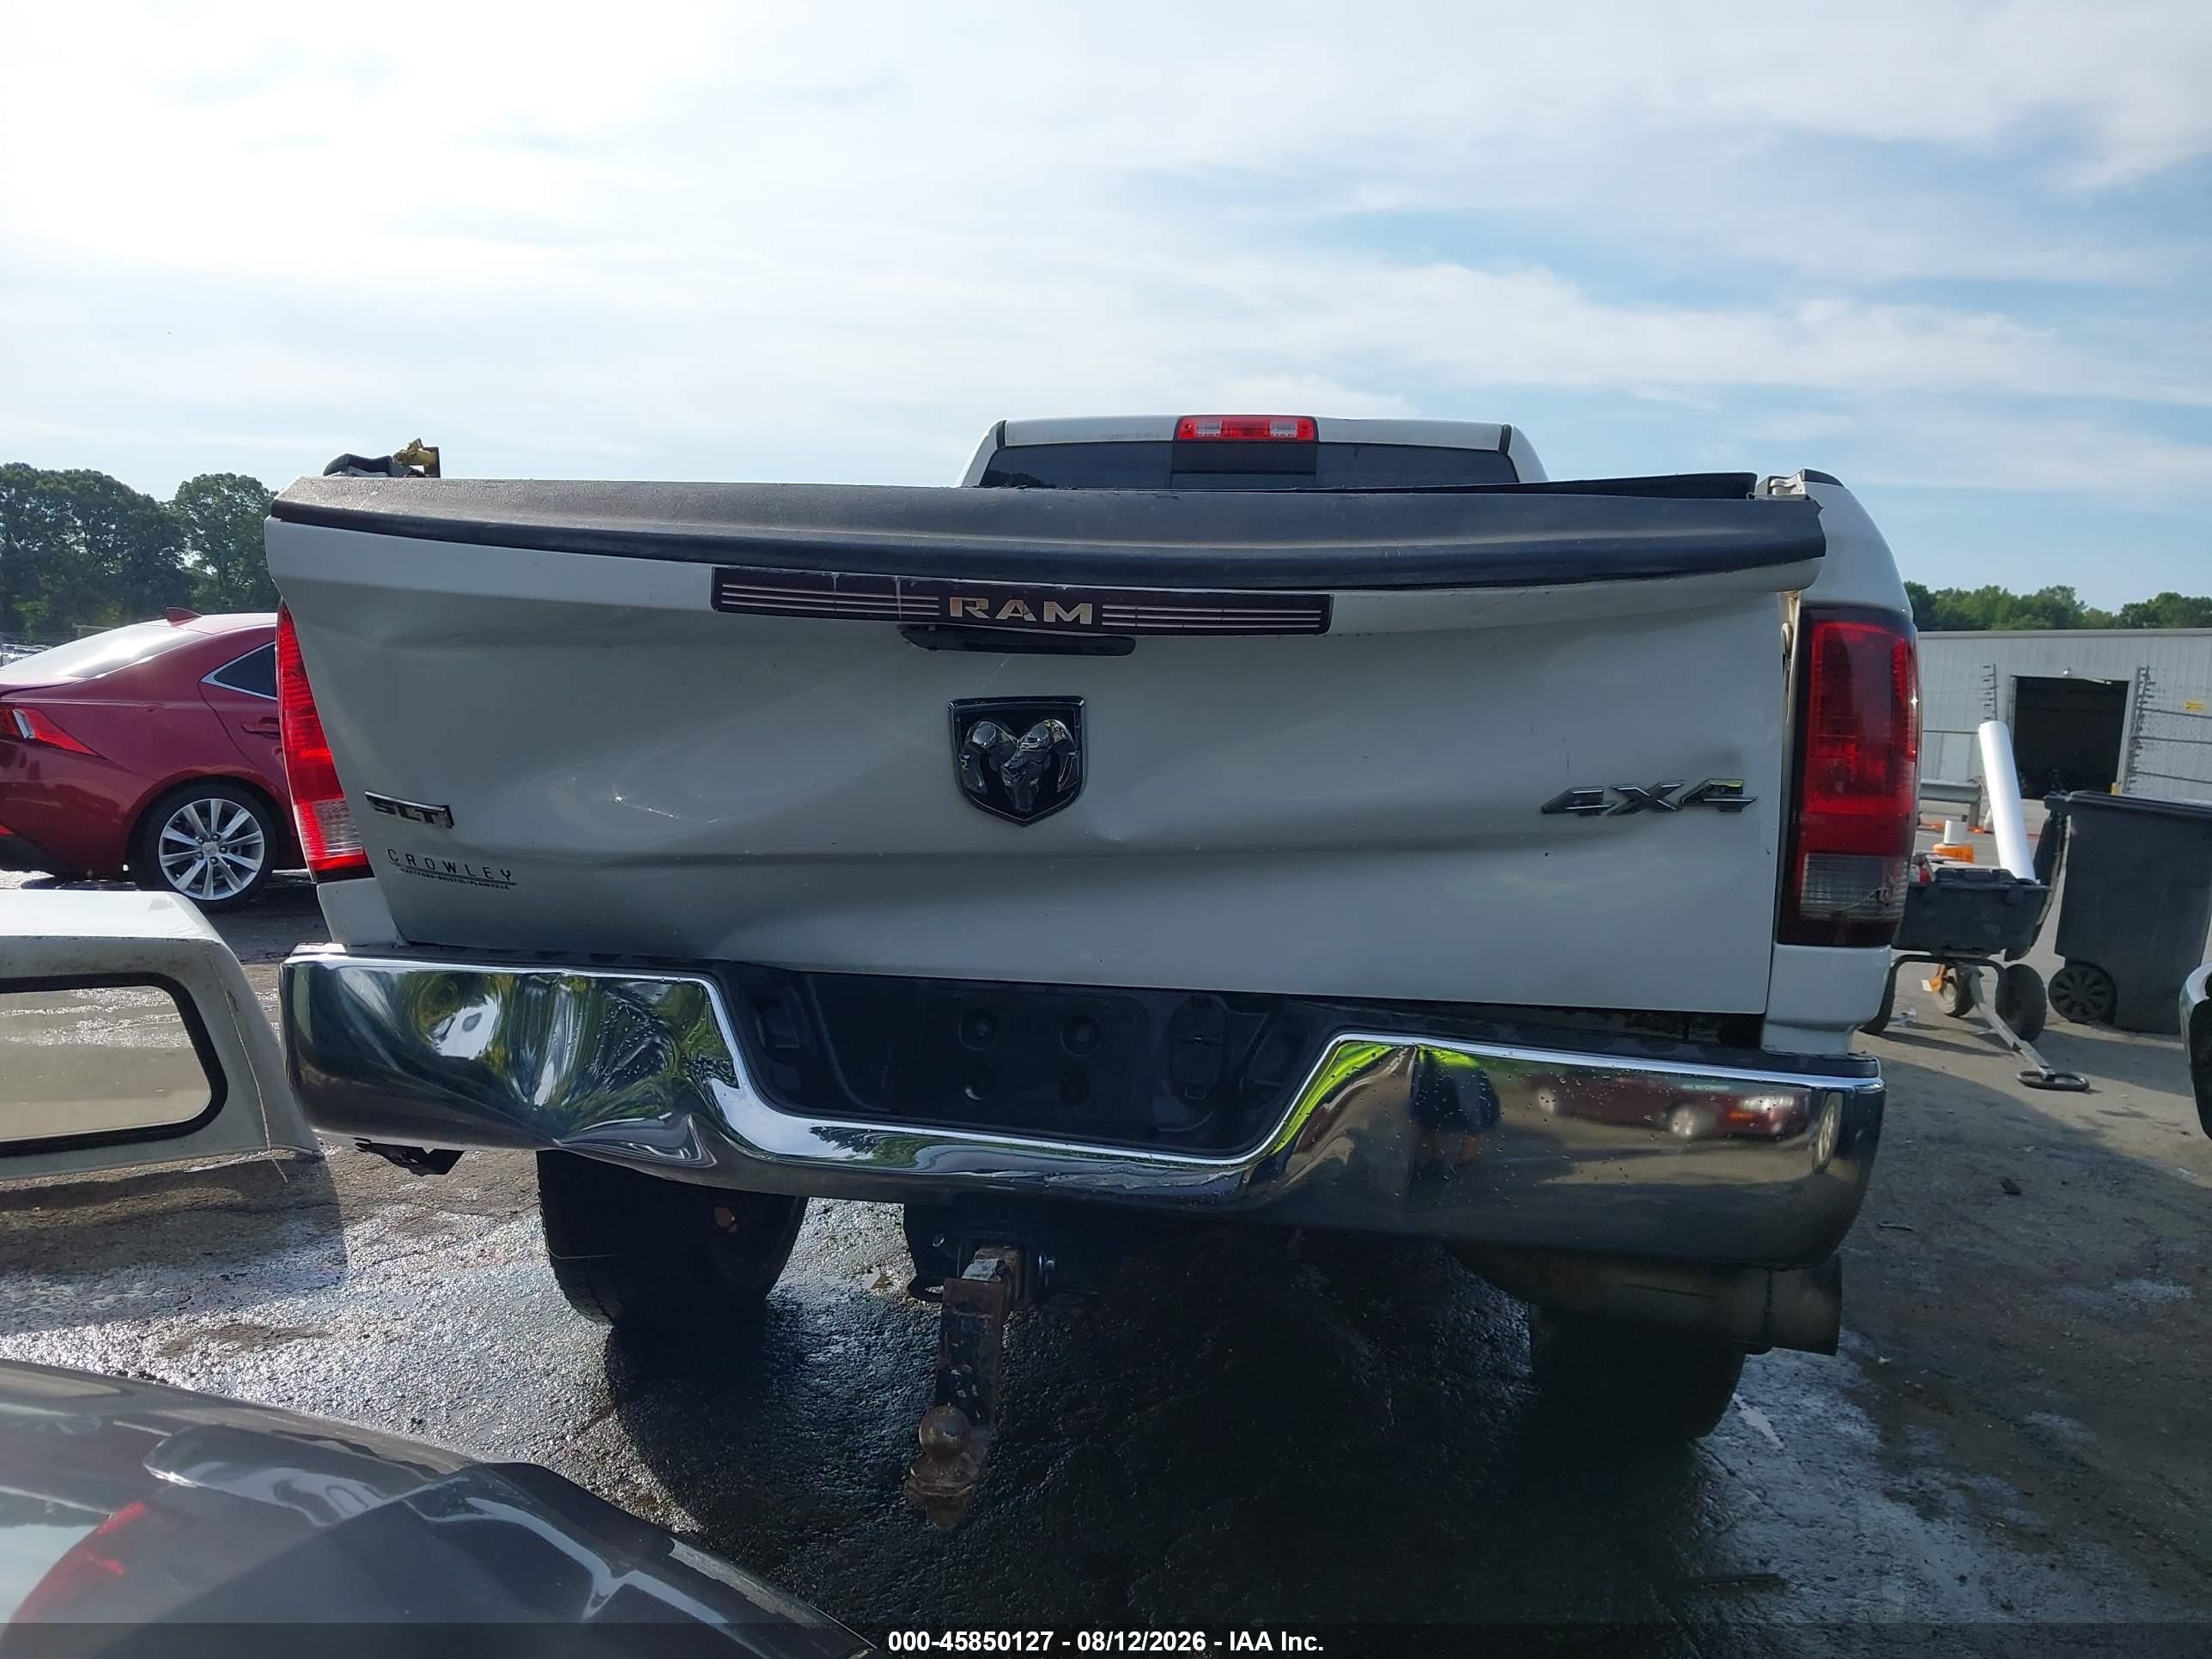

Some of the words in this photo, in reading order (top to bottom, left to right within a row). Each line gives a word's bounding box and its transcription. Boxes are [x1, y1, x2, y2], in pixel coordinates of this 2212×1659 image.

[949, 597, 1093, 625] RAM
[366, 794, 444, 825] SLT
[387, 848, 512, 881] CROWLEY
